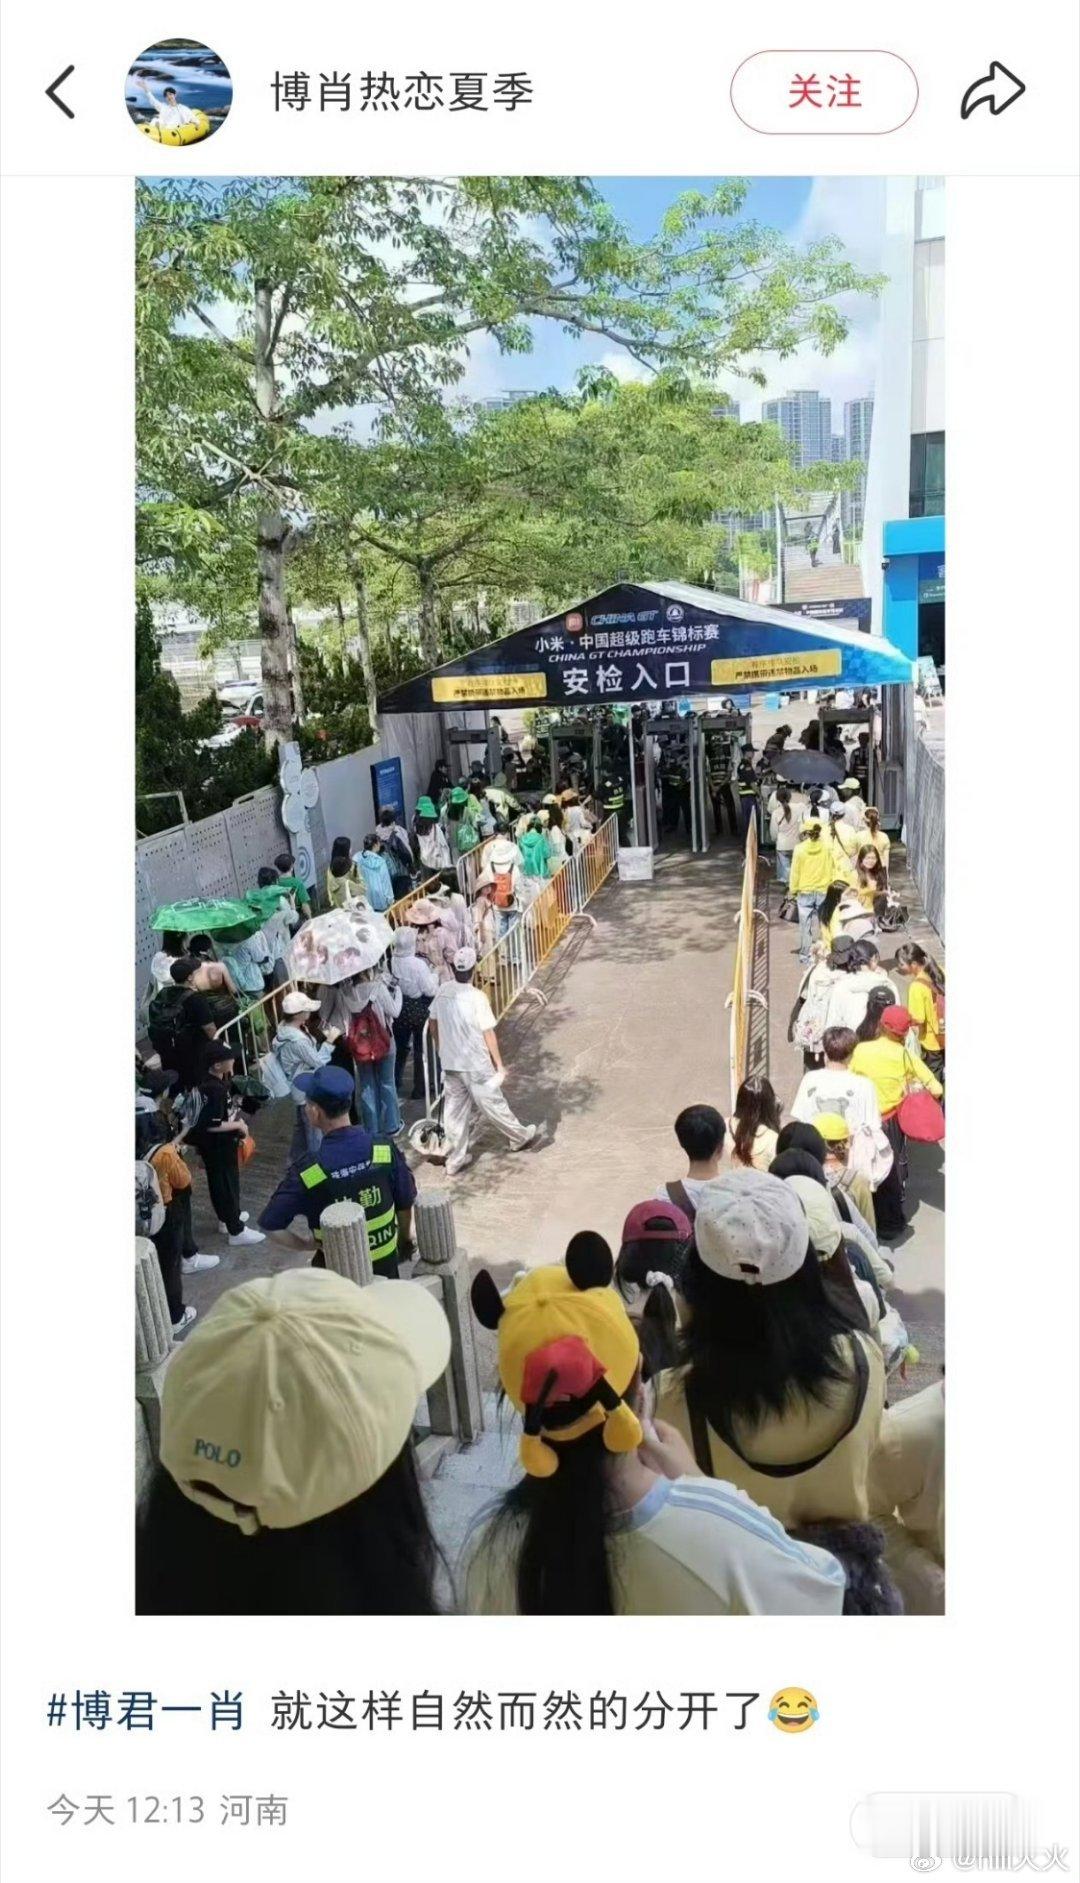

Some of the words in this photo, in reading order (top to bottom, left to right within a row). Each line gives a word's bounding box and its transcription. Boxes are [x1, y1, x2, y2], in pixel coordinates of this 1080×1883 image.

[591, 612, 636, 626] CHINA
[548, 652, 585, 663] CHINA
[589, 650, 603, 660] GT
[607, 643, 707, 659] CHAMPIONSHIP
[562, 661, 690, 696] 安检入口
[194, 1438, 241, 1468] POLO
